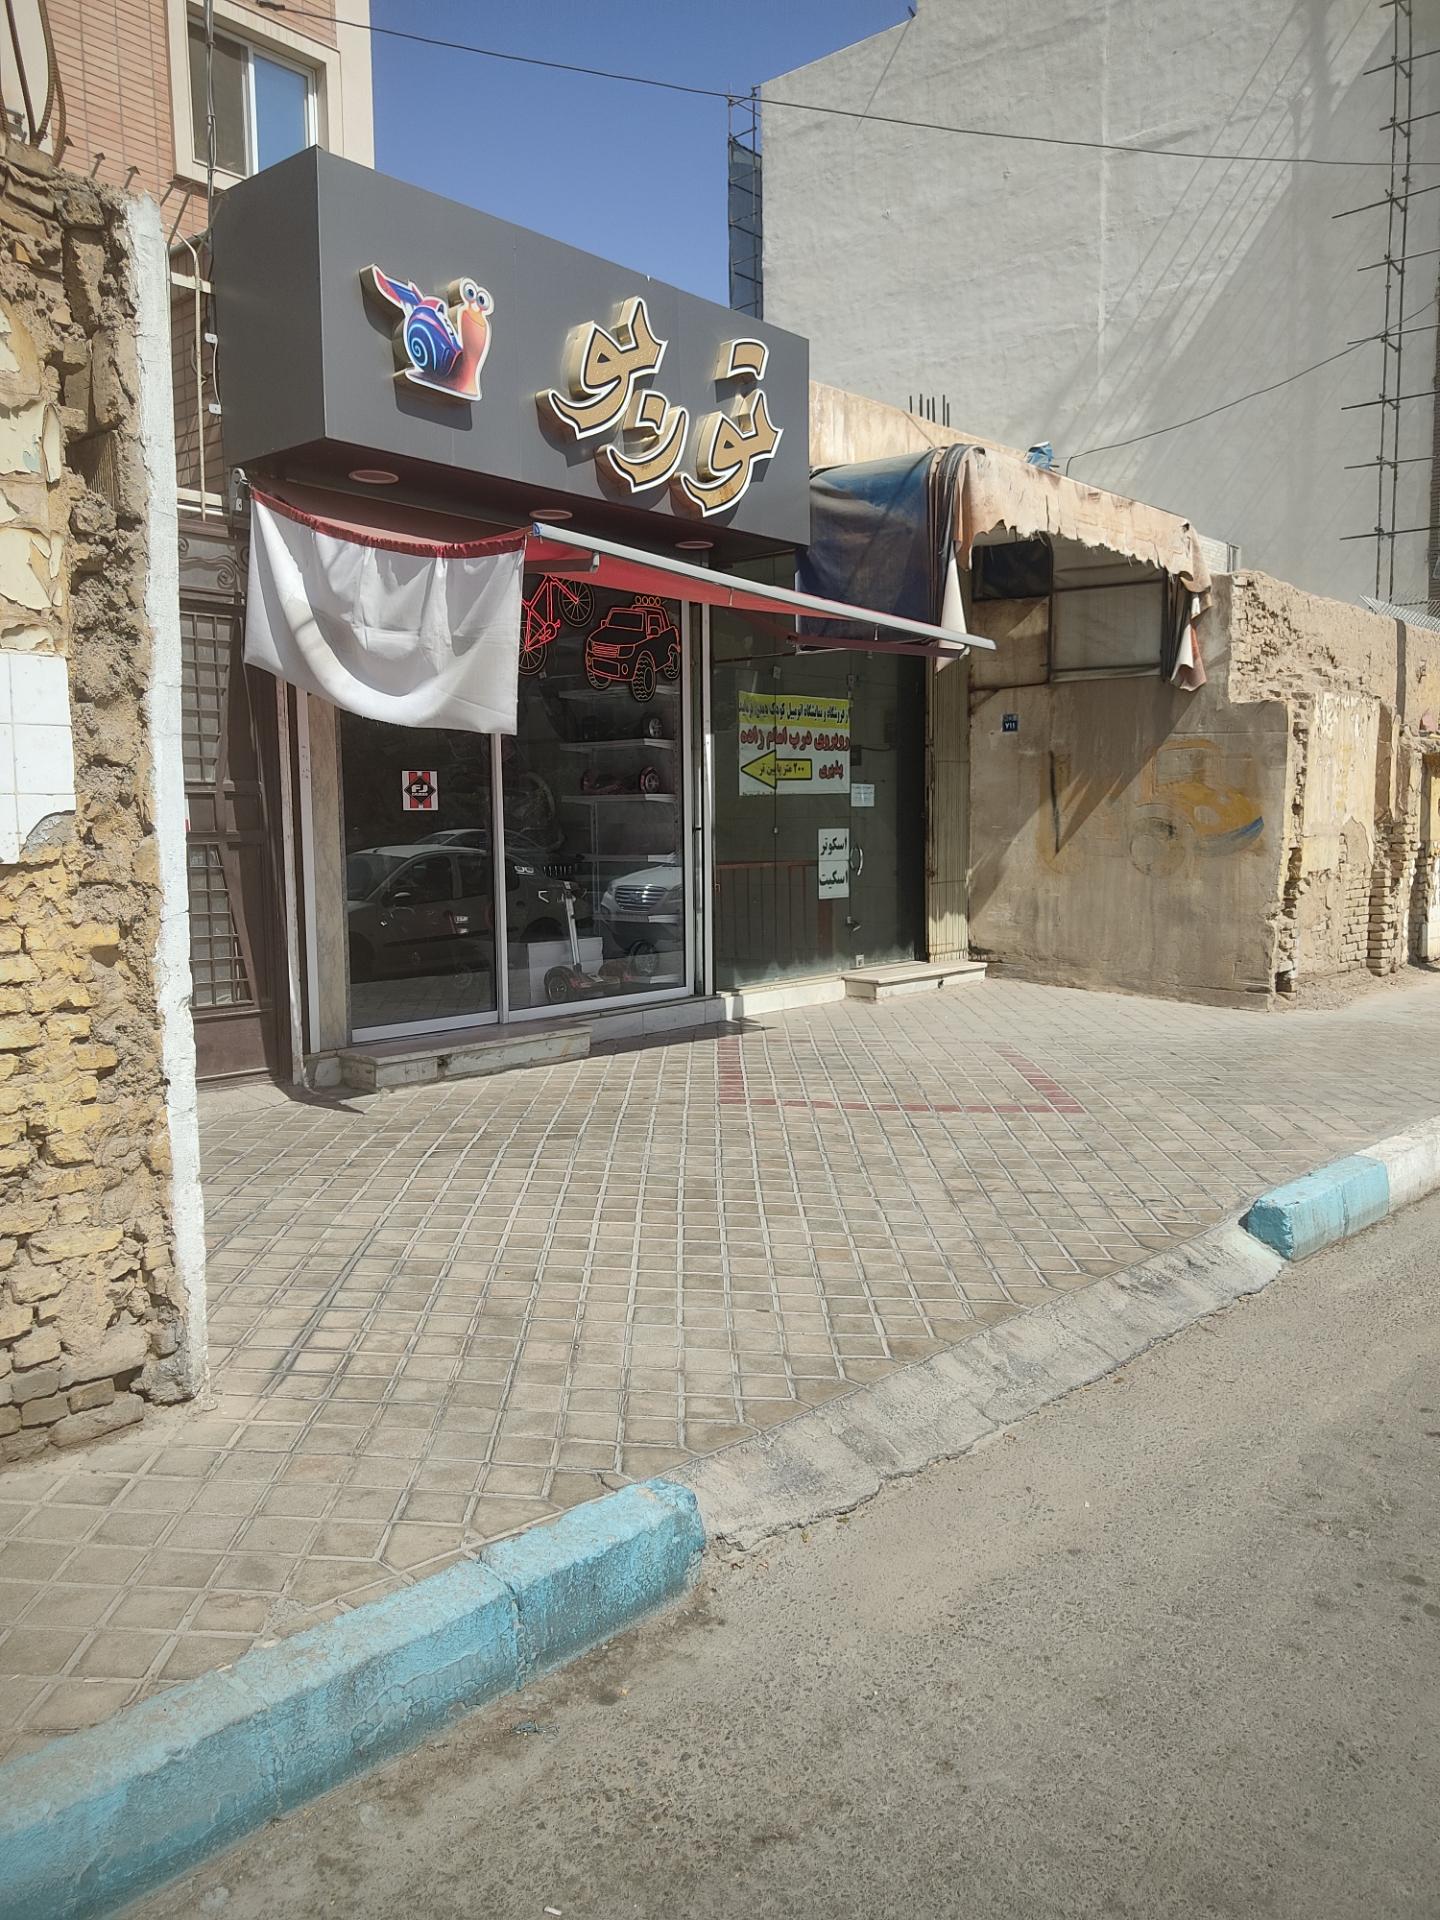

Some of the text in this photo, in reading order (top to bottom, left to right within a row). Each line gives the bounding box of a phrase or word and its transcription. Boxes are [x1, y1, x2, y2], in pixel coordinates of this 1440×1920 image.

[536, 295, 784, 517] توربو
[740, 725, 850, 752] روبروی درب امام زاده
[759, 763, 766, 776] تر
[783, 764, 793, 776] متر
[793, 762, 804, 774] ۲۰۰
[820, 837, 847, 855] اسکوتر
[819, 870, 848, 889] اسکیت
